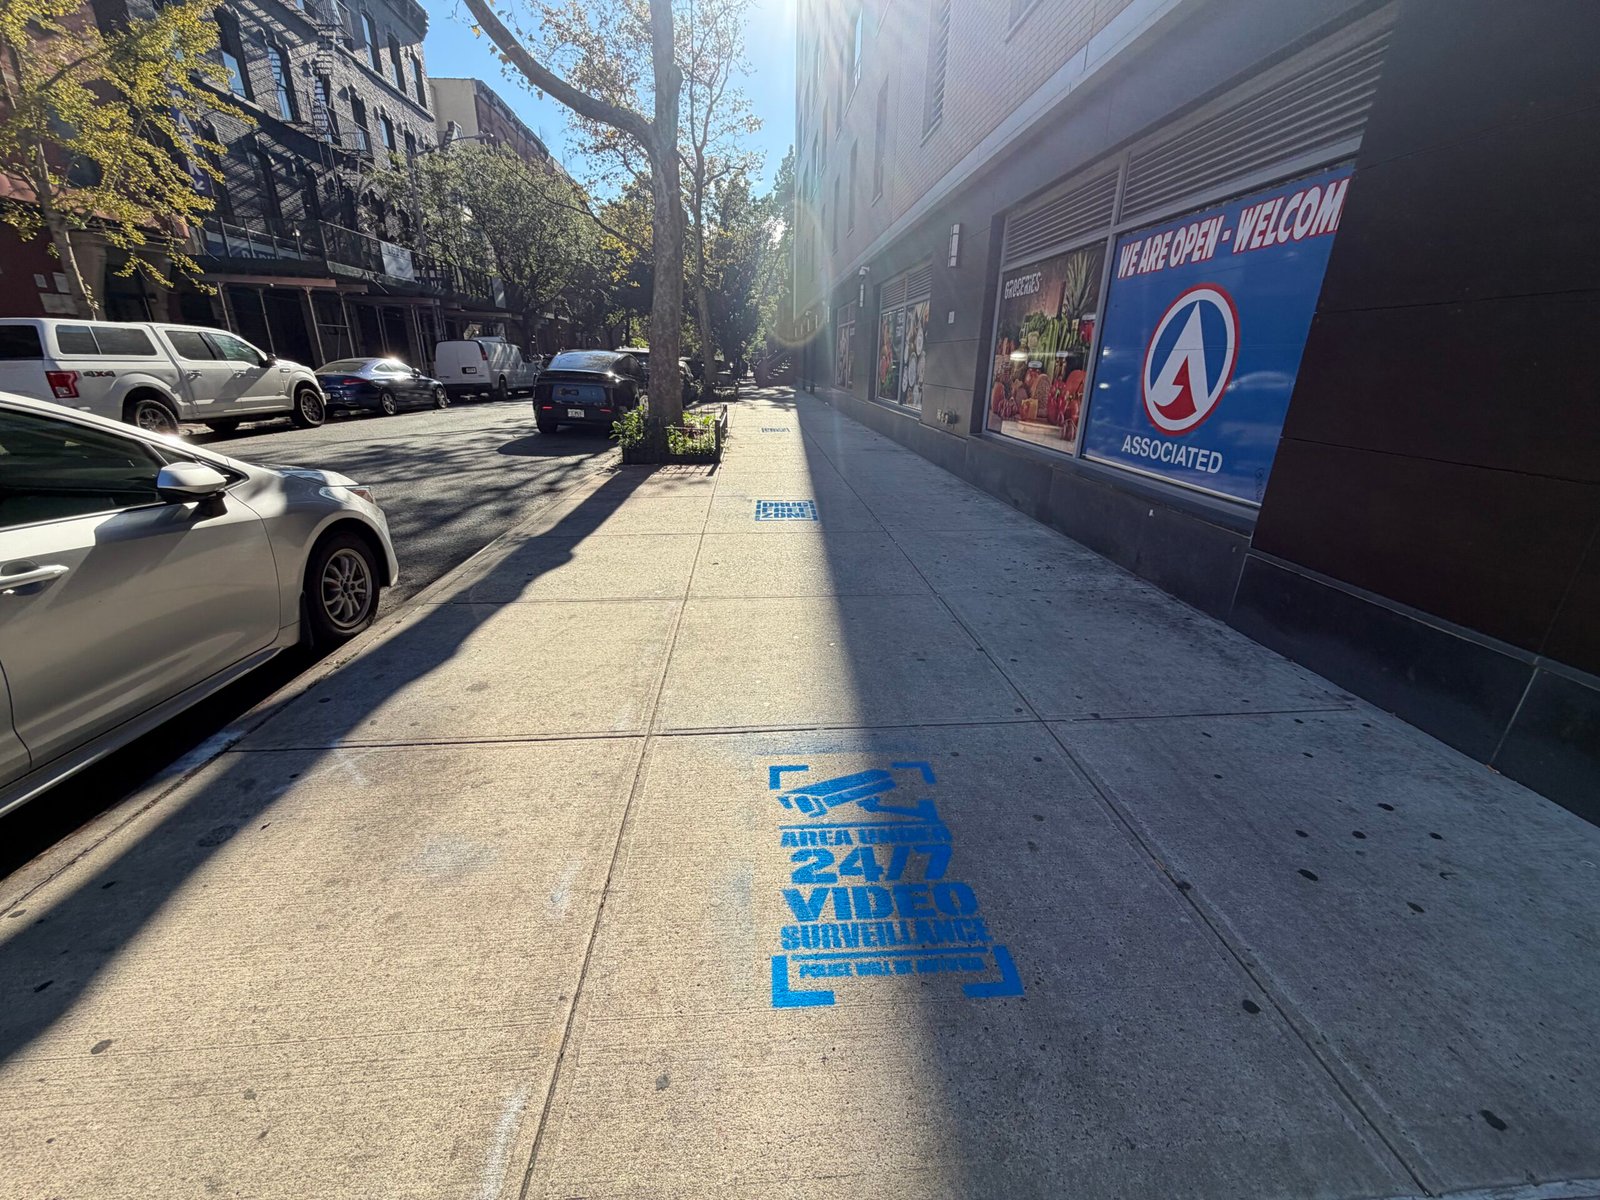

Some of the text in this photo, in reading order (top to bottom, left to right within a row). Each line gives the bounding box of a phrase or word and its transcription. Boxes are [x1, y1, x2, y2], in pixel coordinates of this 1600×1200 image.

[1117, 240, 1141, 279] WE
[1136, 231, 1174, 275] ARE
[1169, 215, 1225, 268] OPEN
[1232, 177, 1350, 254] WELCOM
[1004, 272, 1043, 300] GROCERIES
[1121, 434, 1223, 474] ASSOCIATED
[780, 830, 853, 847] AREA
[790, 844, 953, 884] 24/7
[781, 882, 979, 921] VIDEO
[780, 916, 994, 950] SURVEILLANCE
